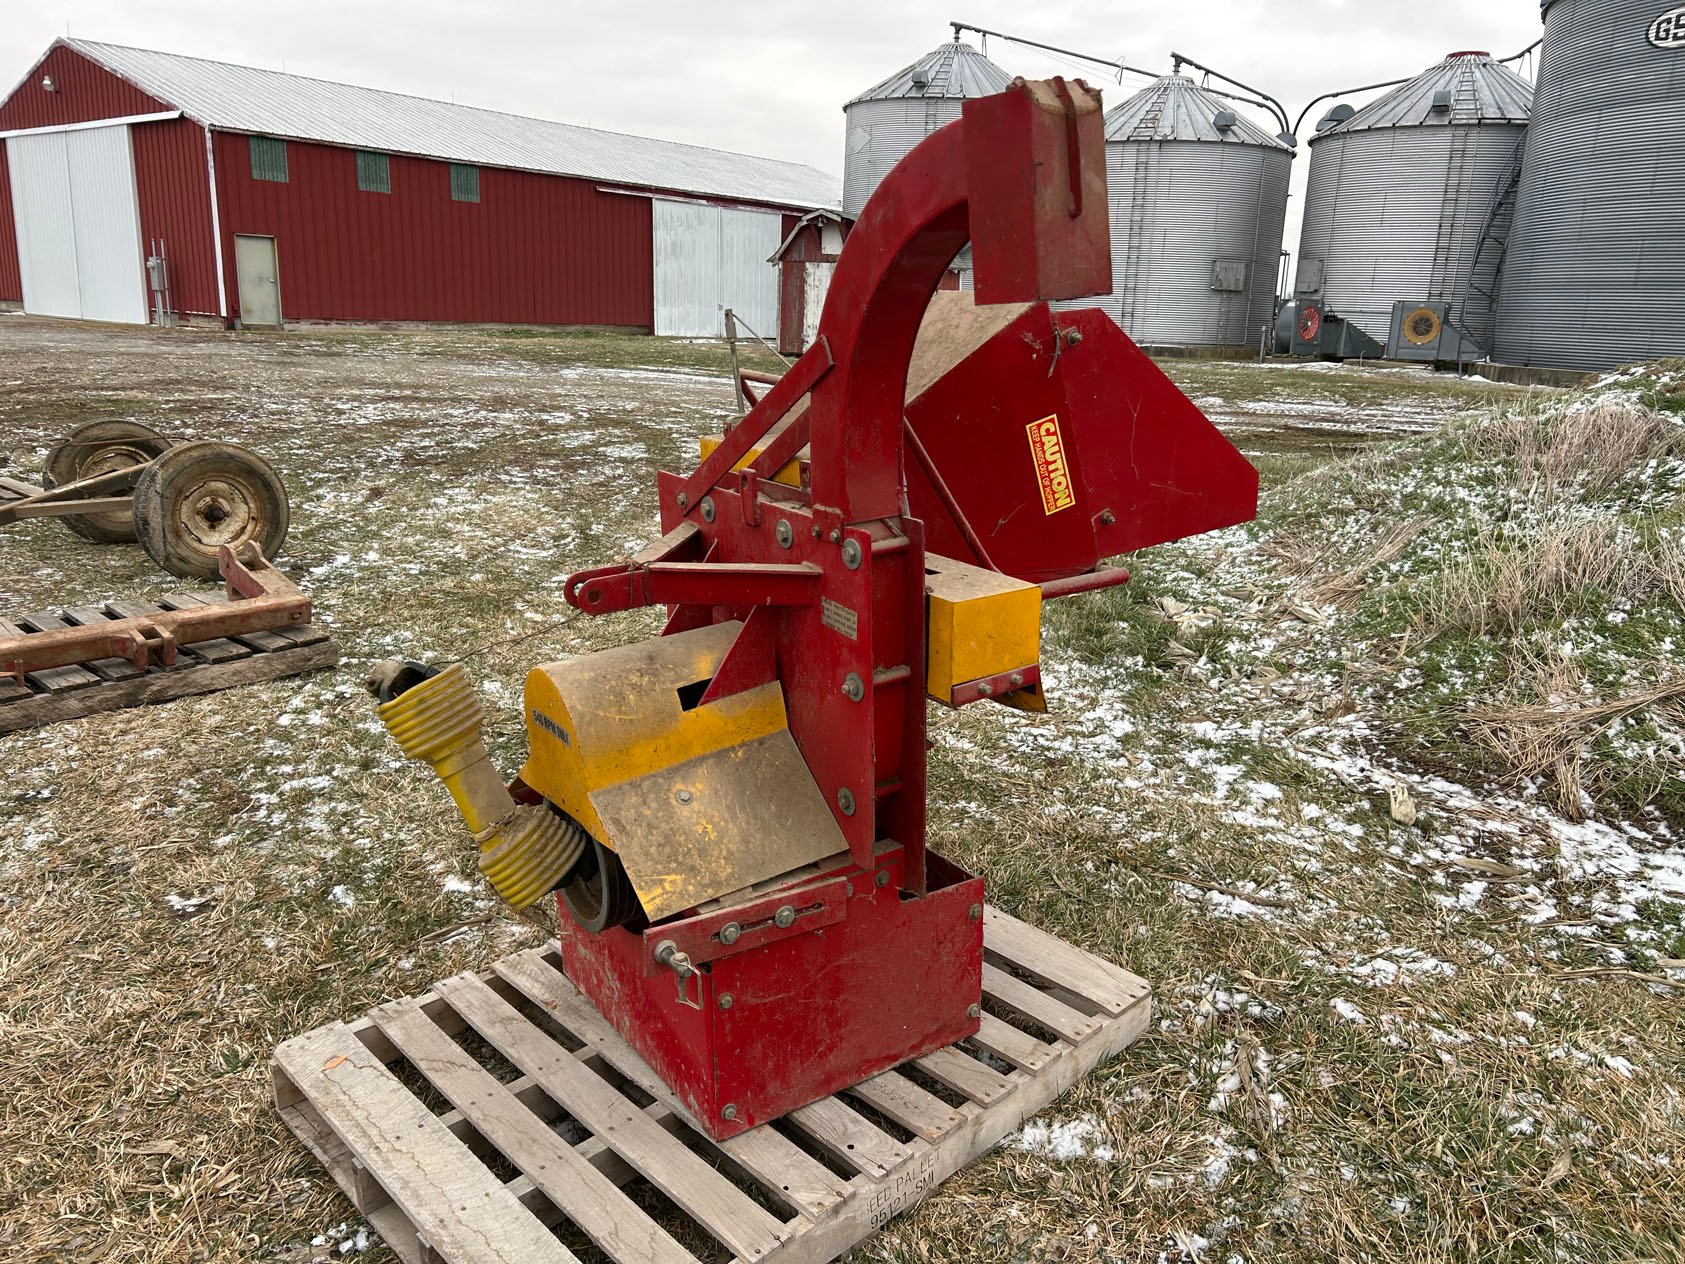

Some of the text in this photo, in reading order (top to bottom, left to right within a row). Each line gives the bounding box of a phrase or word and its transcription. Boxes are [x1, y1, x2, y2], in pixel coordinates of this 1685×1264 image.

[1030, 425, 1056, 511] KEEP HANDS OUT OF HOPPER
[1040, 421, 1071, 508] CAUTION
[543, 716, 557, 735] RPM
[556, 725, 569, 744] ONLY
